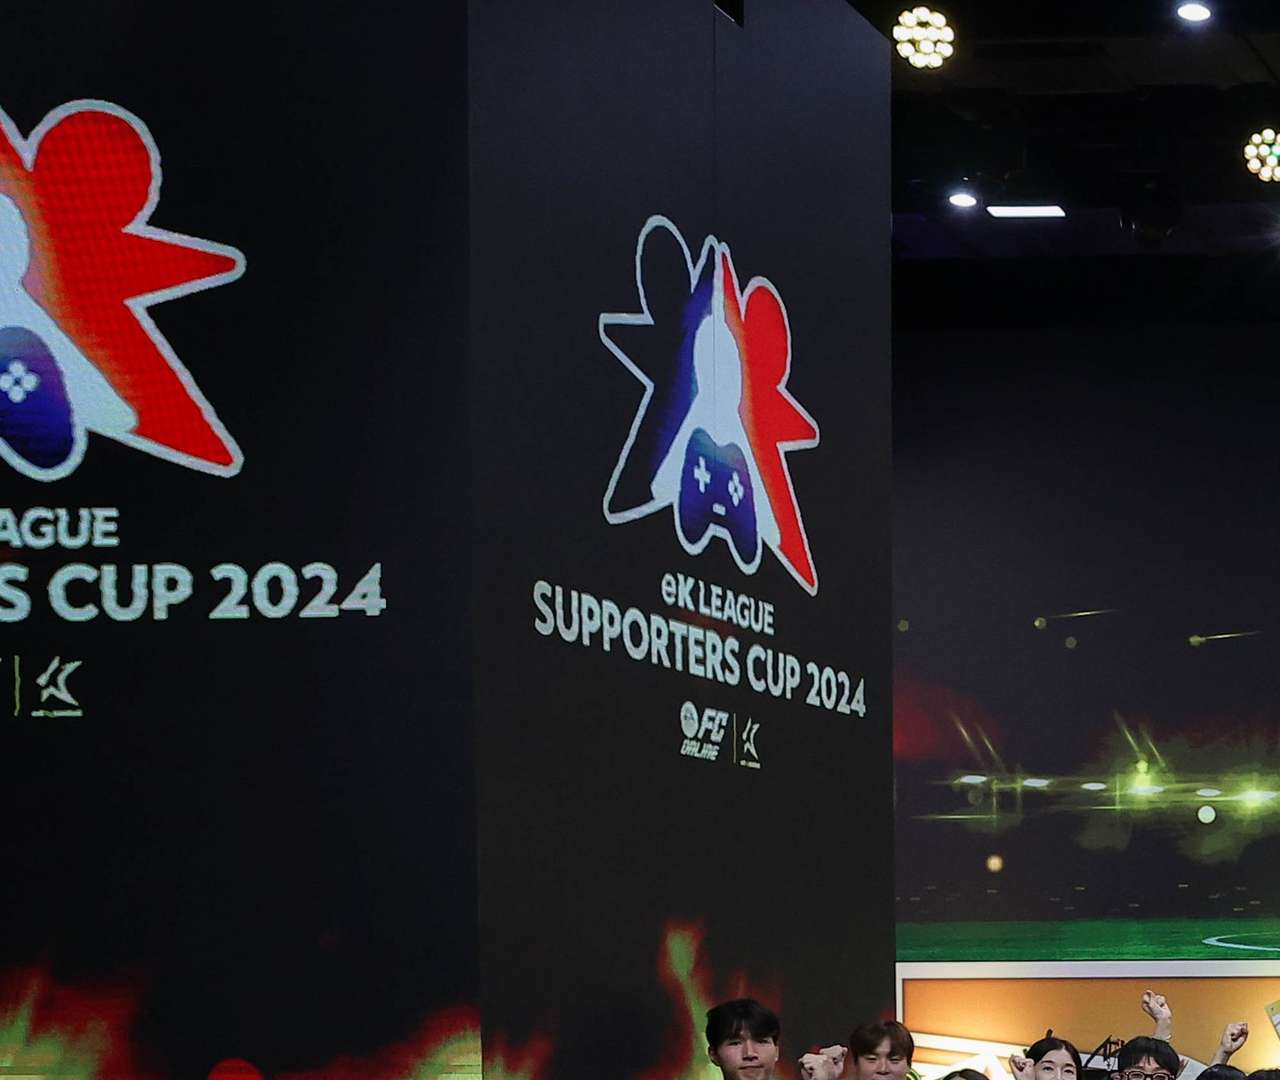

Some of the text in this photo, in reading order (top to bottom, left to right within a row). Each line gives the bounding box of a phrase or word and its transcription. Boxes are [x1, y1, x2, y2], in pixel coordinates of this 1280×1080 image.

[48, 562, 193, 622] CUP
[209, 561, 387, 620] 2024
[698, 582, 776, 636] LEAGUE
[532, 580, 868, 719] SUPPORTERS CUP 2024
